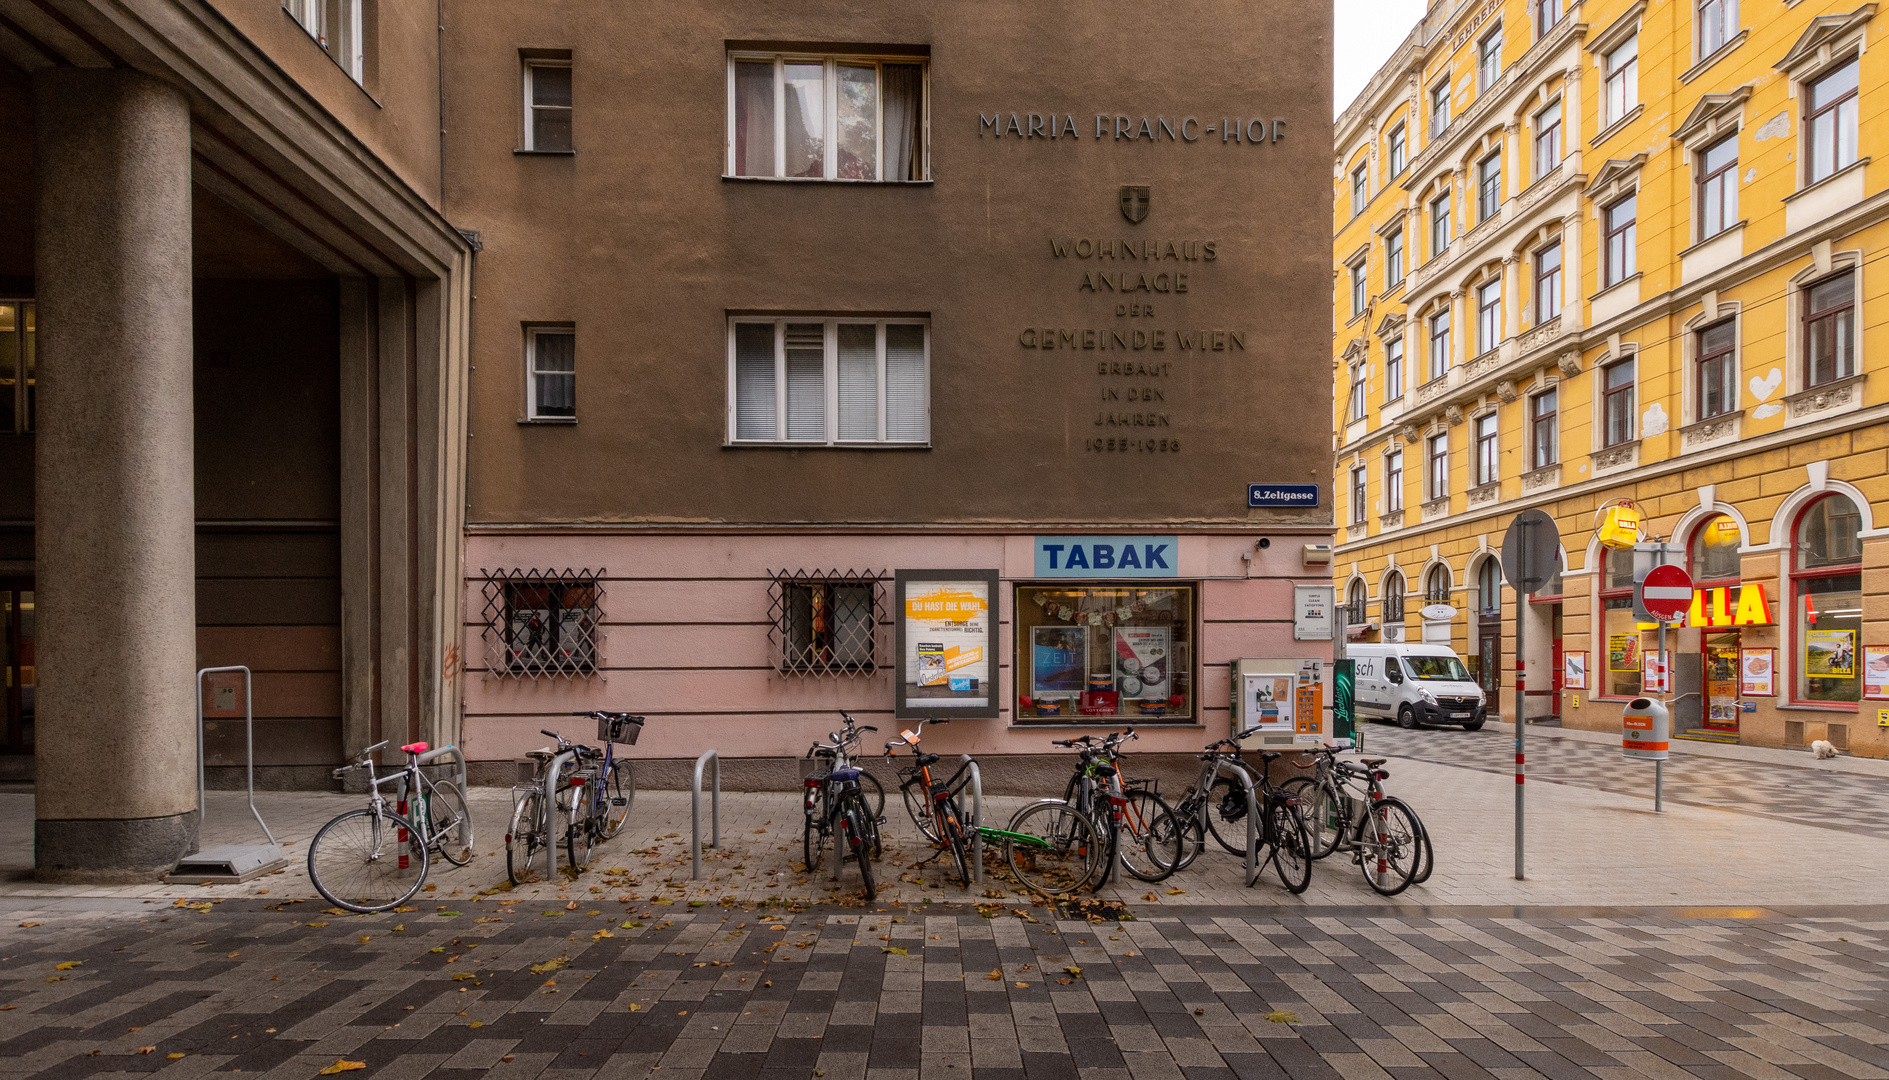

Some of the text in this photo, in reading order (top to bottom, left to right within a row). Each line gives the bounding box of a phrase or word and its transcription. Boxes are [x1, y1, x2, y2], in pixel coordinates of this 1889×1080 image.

[979, 112, 1287, 143] MARIA FRANC-HOF
[1050, 238, 1218, 261] WOHNHAUS
[1079, 271, 1189, 293] ANLAGE
[1116, 302, 1155, 317] DER
[1019, 327, 1247, 351] GEMEINDE WIEN
[1098, 362, 1172, 377] ERBAUT
[1102, 388, 1165, 401] IN DEN
[1095, 412, 1169, 427] JAHREN
[1618, 520, 1636, 529] BILLA
[1042, 544, 1170, 570] TABAK
[912, 601, 984, 611] DU HAST DIE WAHL.
[1042, 652, 1076, 664] ZEIT
[1355, 658, 1374, 676] sch
